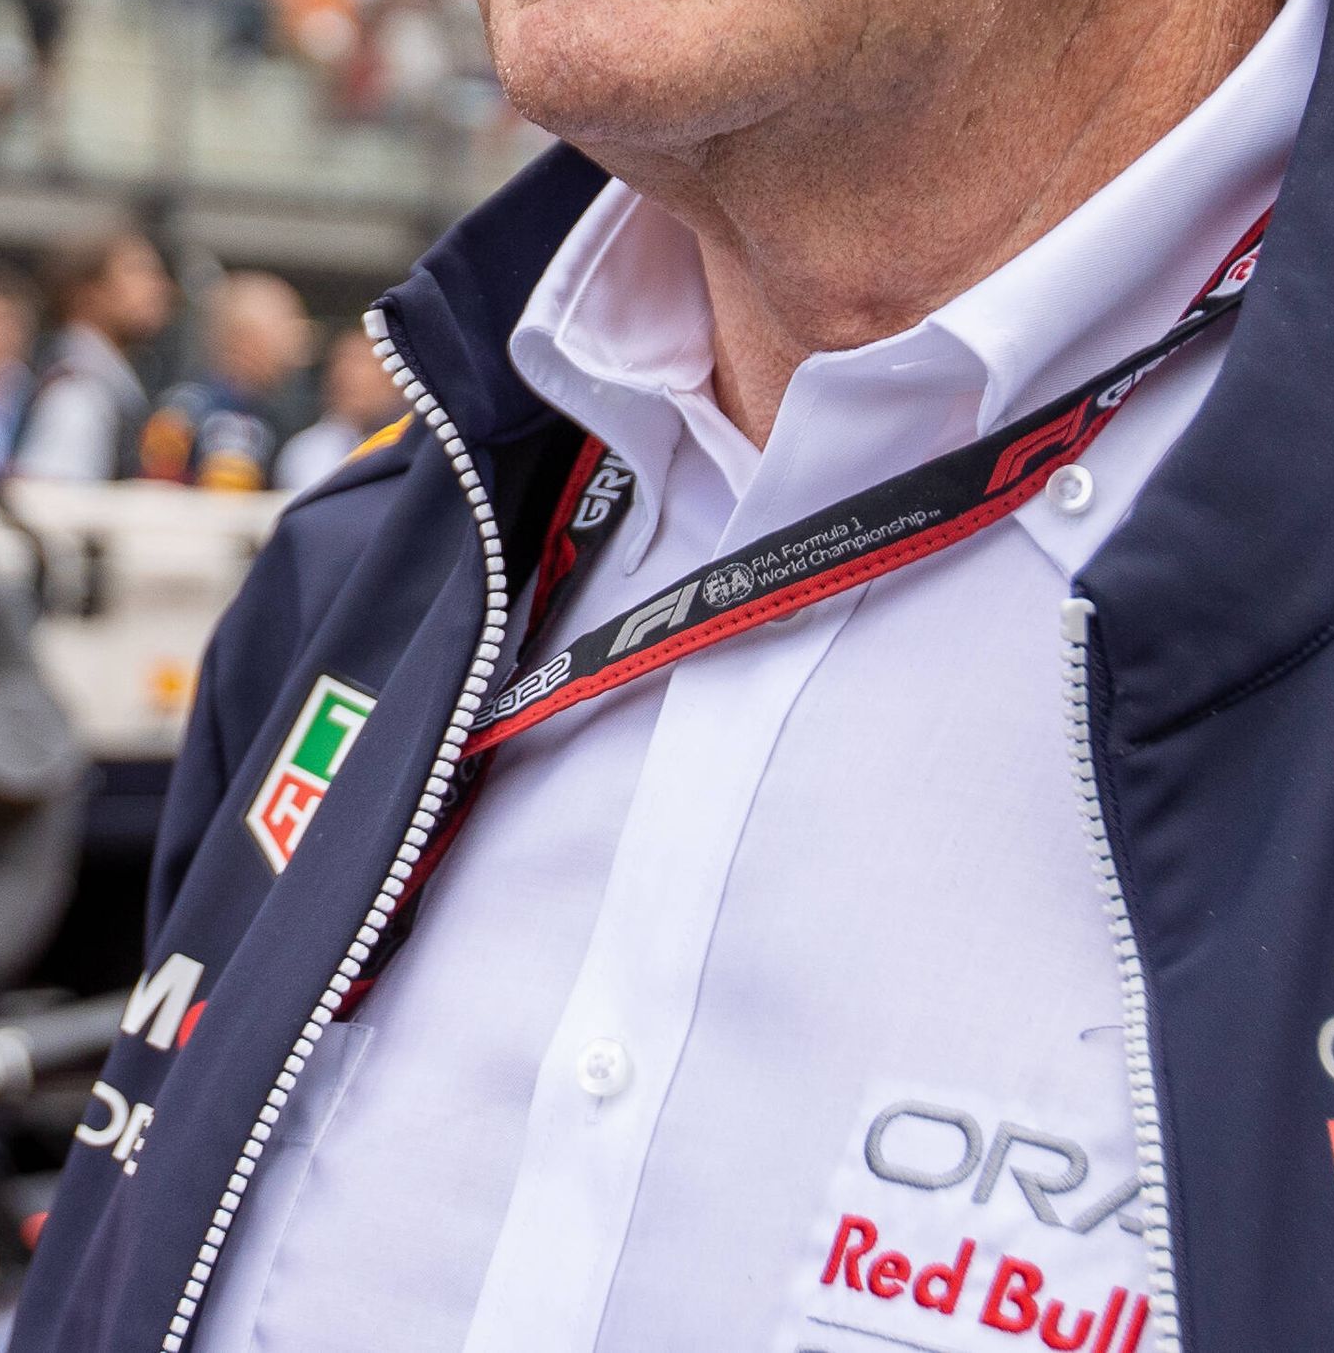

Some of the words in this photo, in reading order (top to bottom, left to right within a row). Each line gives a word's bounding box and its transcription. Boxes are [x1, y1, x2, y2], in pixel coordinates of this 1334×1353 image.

[752, 552, 781, 573] FIA
[781, 524, 849, 557] Formula
[850, 516, 864, 532] 1
[756, 557, 808, 587] World
[468, 651, 573, 733] 2022
[820, 1213, 977, 1315] Red
[978, 1253, 1151, 1353] Bull
